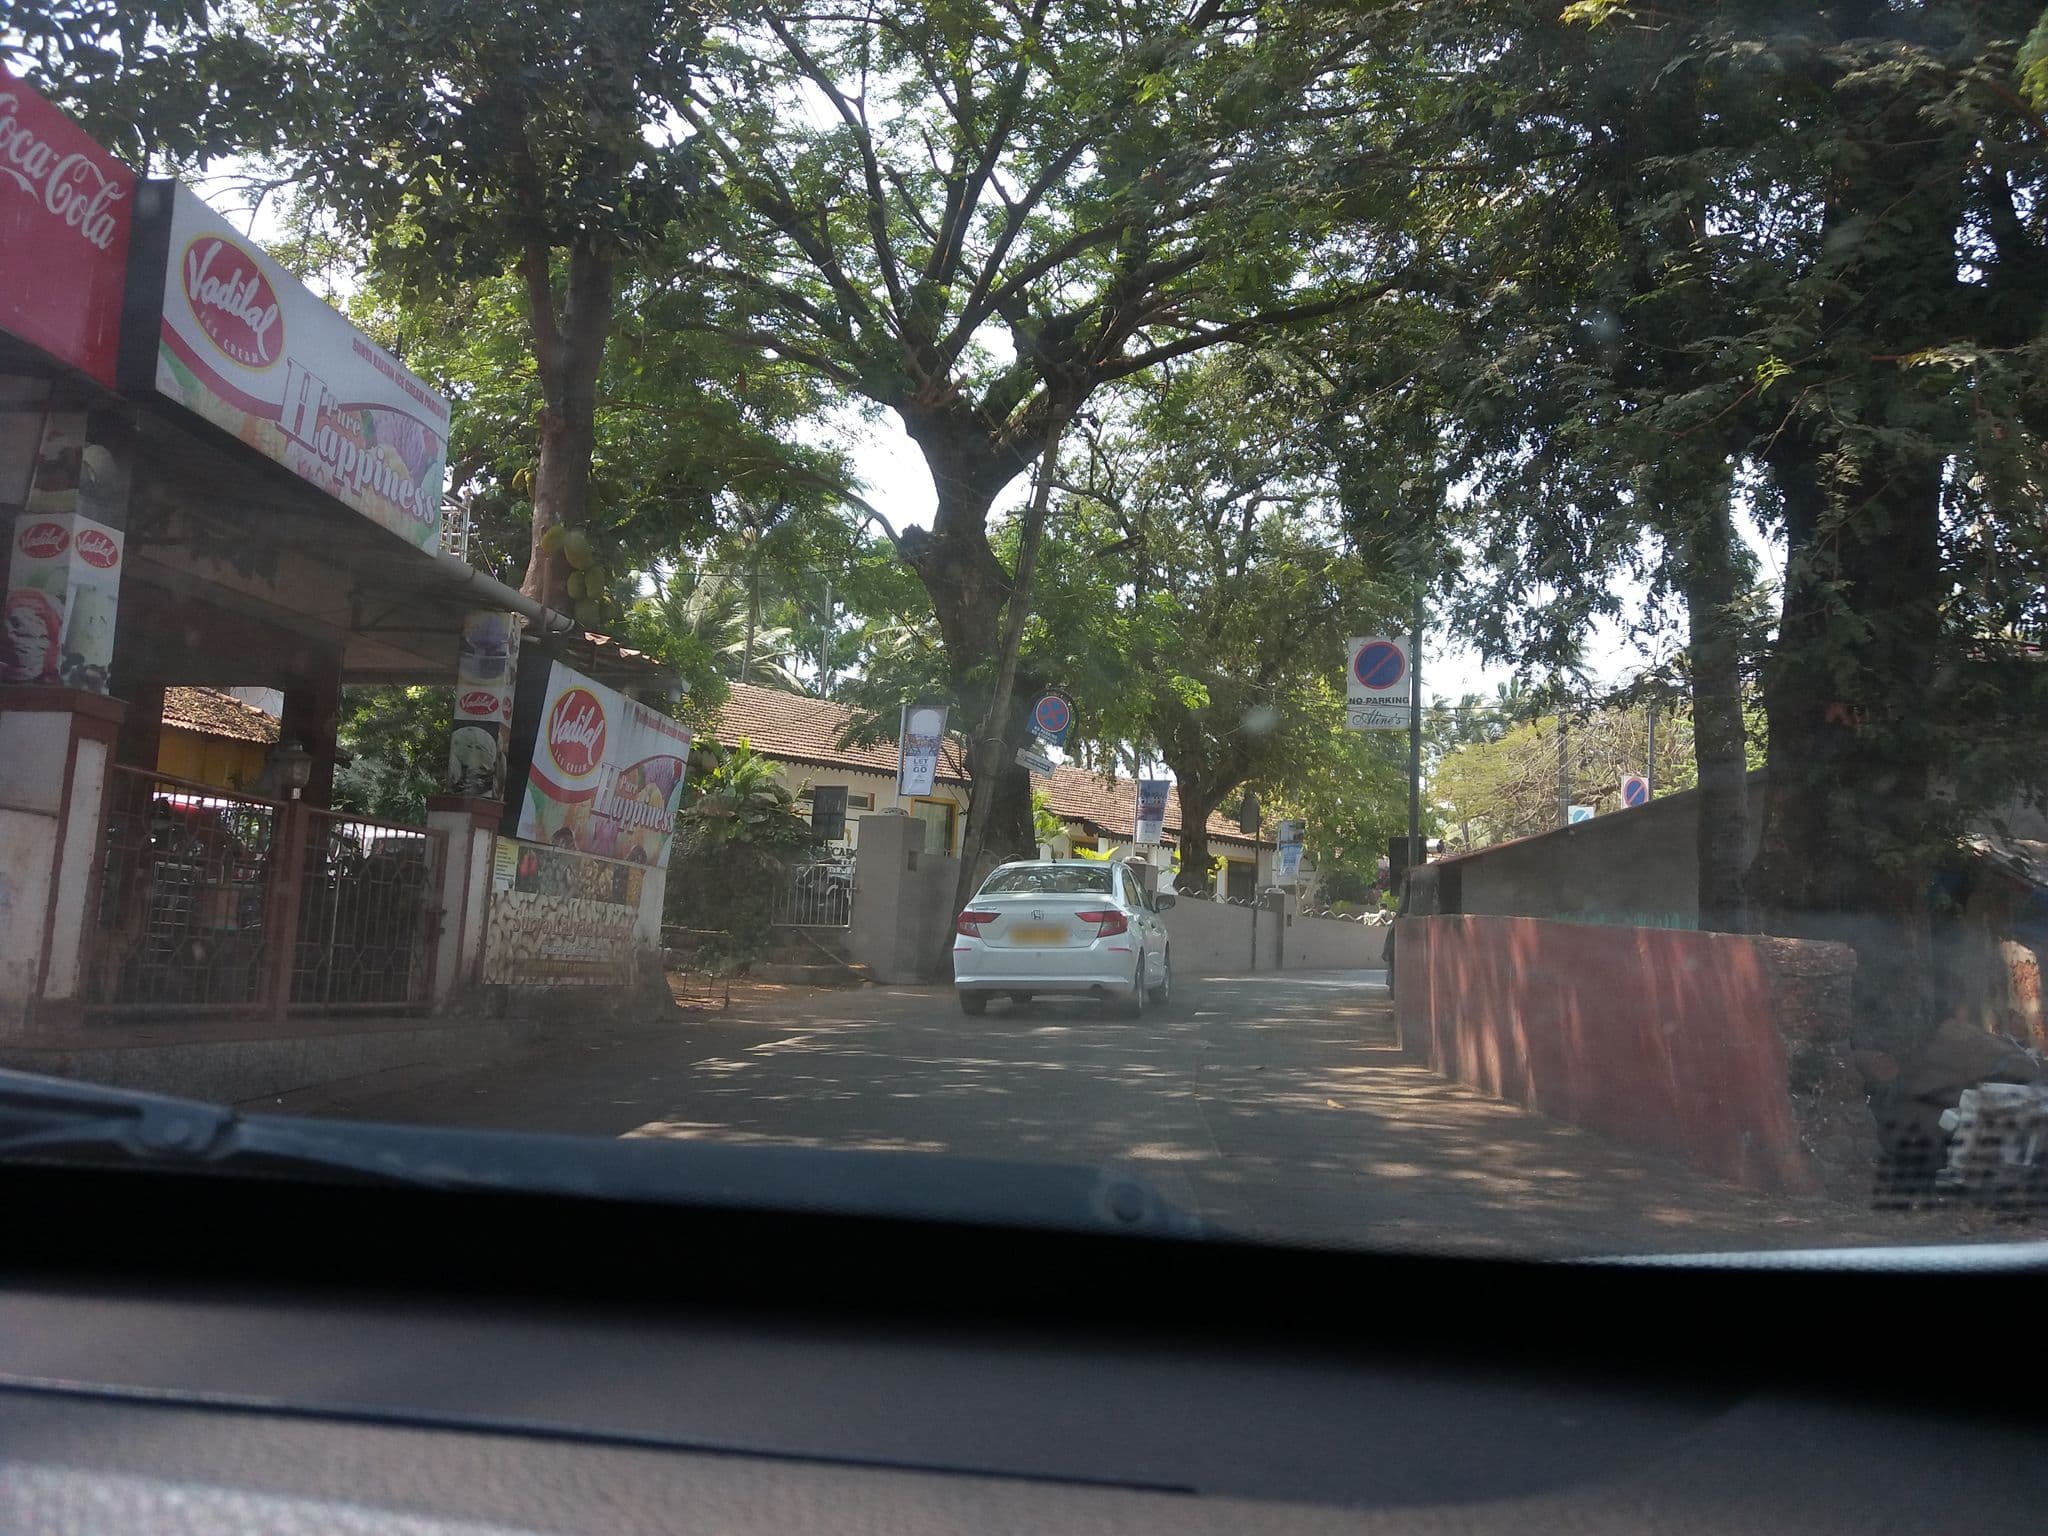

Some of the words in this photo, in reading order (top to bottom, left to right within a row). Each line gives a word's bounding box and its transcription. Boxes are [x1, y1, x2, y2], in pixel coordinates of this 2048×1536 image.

[188, 240, 278, 361] Vadilal
[275, 357, 436, 527] Happiness
[326, 394, 361, 435] Pure
[78, 531, 116, 566] Vadilal
[461, 693, 498, 712] Vadilal
[551, 691, 605, 766] Vadilal
[1350, 697, 1364, 705] NO
[1366, 697, 1409, 705] PARKING
[592, 762, 677, 834] Happiness
